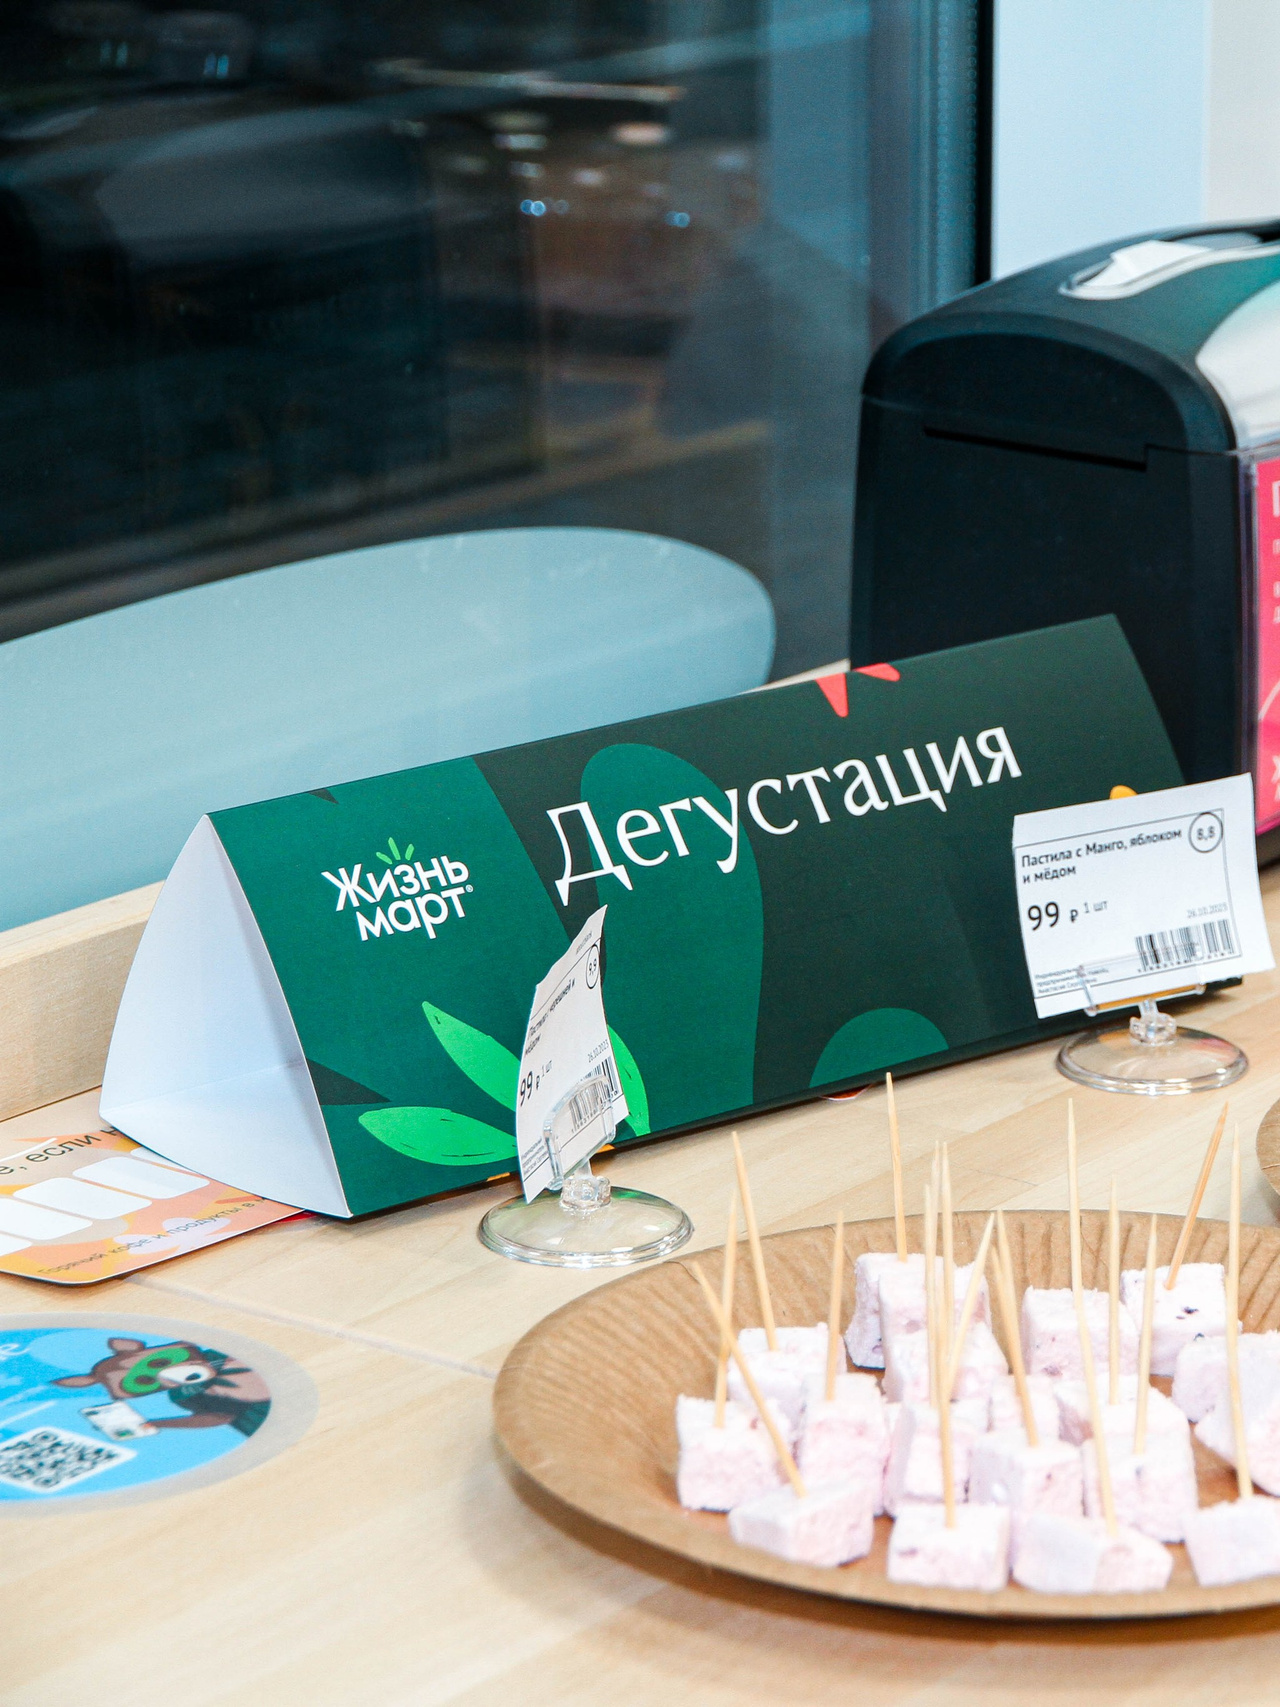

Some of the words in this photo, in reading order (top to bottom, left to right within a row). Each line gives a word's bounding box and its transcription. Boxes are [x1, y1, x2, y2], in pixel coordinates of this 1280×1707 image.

[546, 726, 1022, 907] Дегустация
[1021, 849, 1073, 868] Пастила
[1076, 848, 1082, 858] с
[1085, 836, 1128, 857] Манго,
[1130, 828, 1182, 848] яблоком
[320, 855, 469, 912] Жизнь
[1023, 874, 1031, 884] и
[1034, 864, 1077, 883] мёдом
[355, 886, 466, 942] март
[1027, 901, 1060, 931] 99
[1093, 900, 1109, 912] шт
[588, 957, 598, 977] 9,9
[587, 1039, 609, 1063] 26.10.2023
[520, 1071, 533, 1107] 99
[25, 1134, 102, 1163] если
[110, 1235, 152, 1254] кофе
[165, 1207, 242, 1235] продукты
